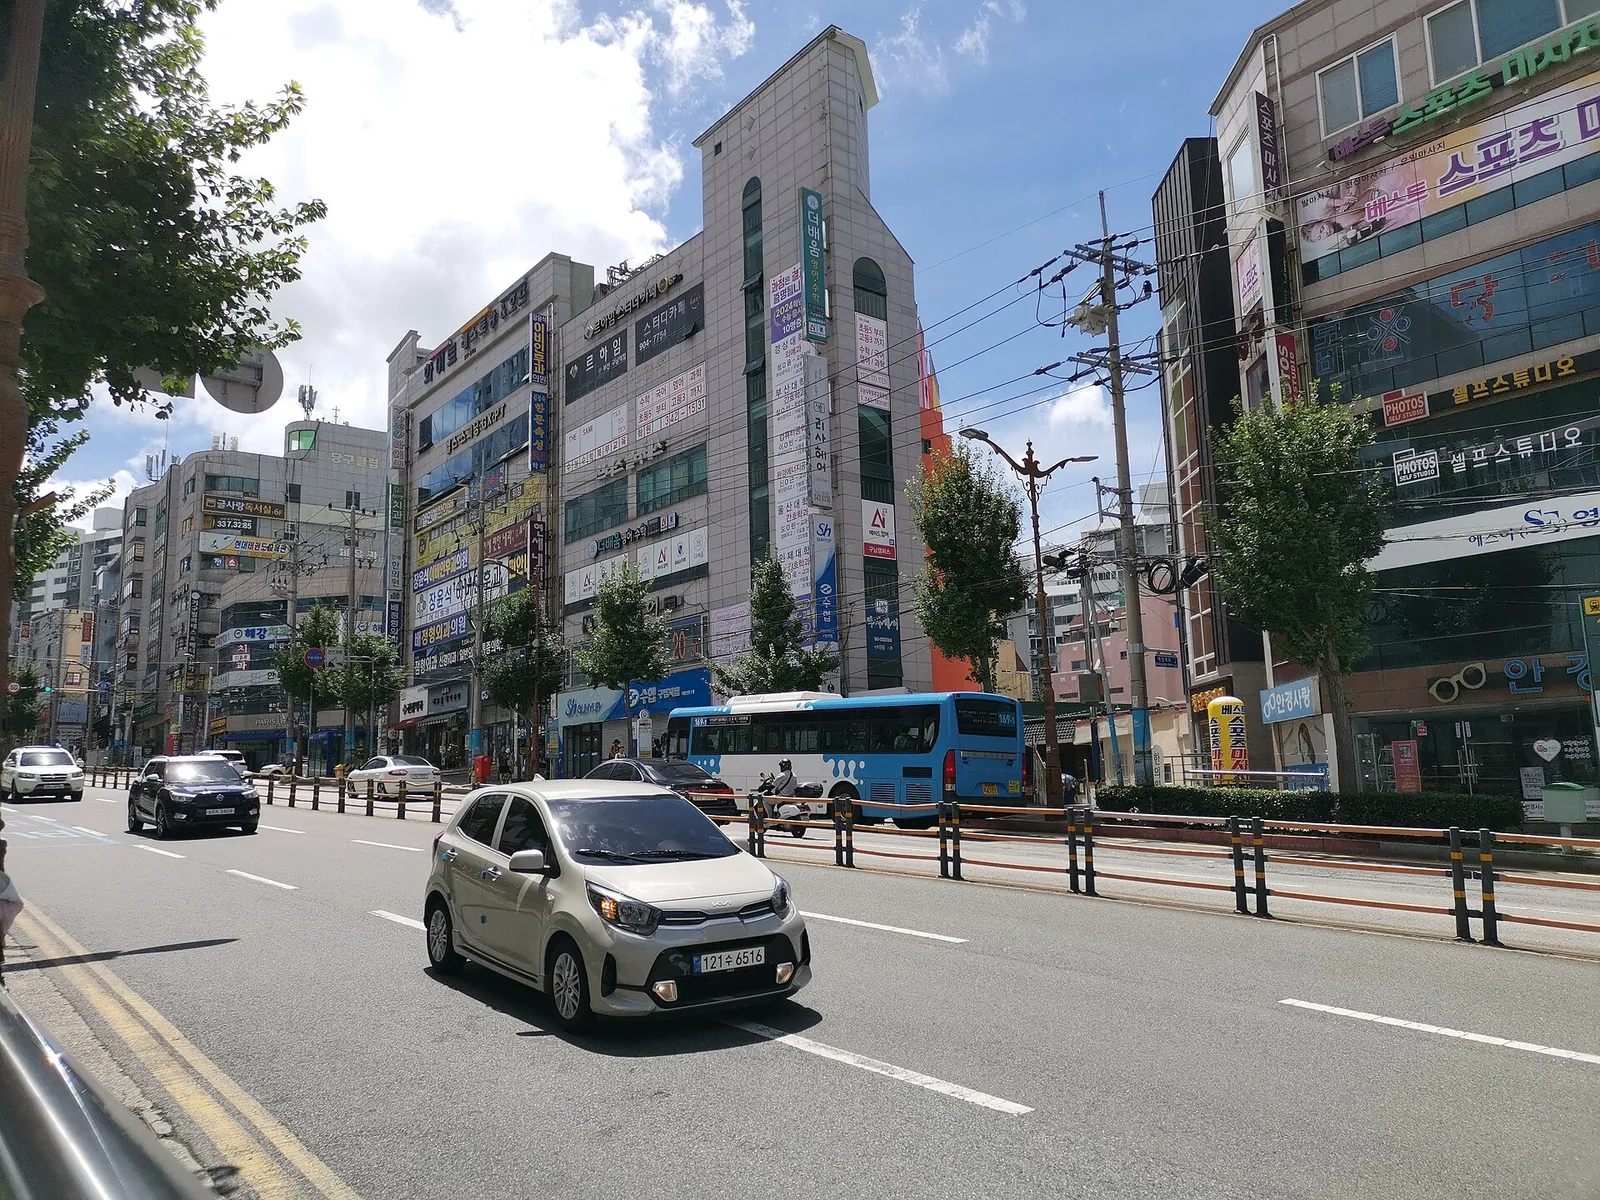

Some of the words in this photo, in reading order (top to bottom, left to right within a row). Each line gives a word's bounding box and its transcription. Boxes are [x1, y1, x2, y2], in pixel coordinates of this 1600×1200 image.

[1332, 116, 1390, 161] 베스트
[1391, 70, 1493, 136] 스포츠
[1366, 180, 1429, 221] 베스트
[1438, 115, 1561, 198] 스포츠
[1452, 357, 1576, 405] 셀프스튜디오
[1385, 397, 1425, 414] PHOTOS
[1396, 457, 1437, 477] PHOTOS
[1450, 427, 1583, 473] 셀프스튜디오
[1276, 686, 1311, 714] 안경사랑
[999, 714, 1016, 725] 169-1
